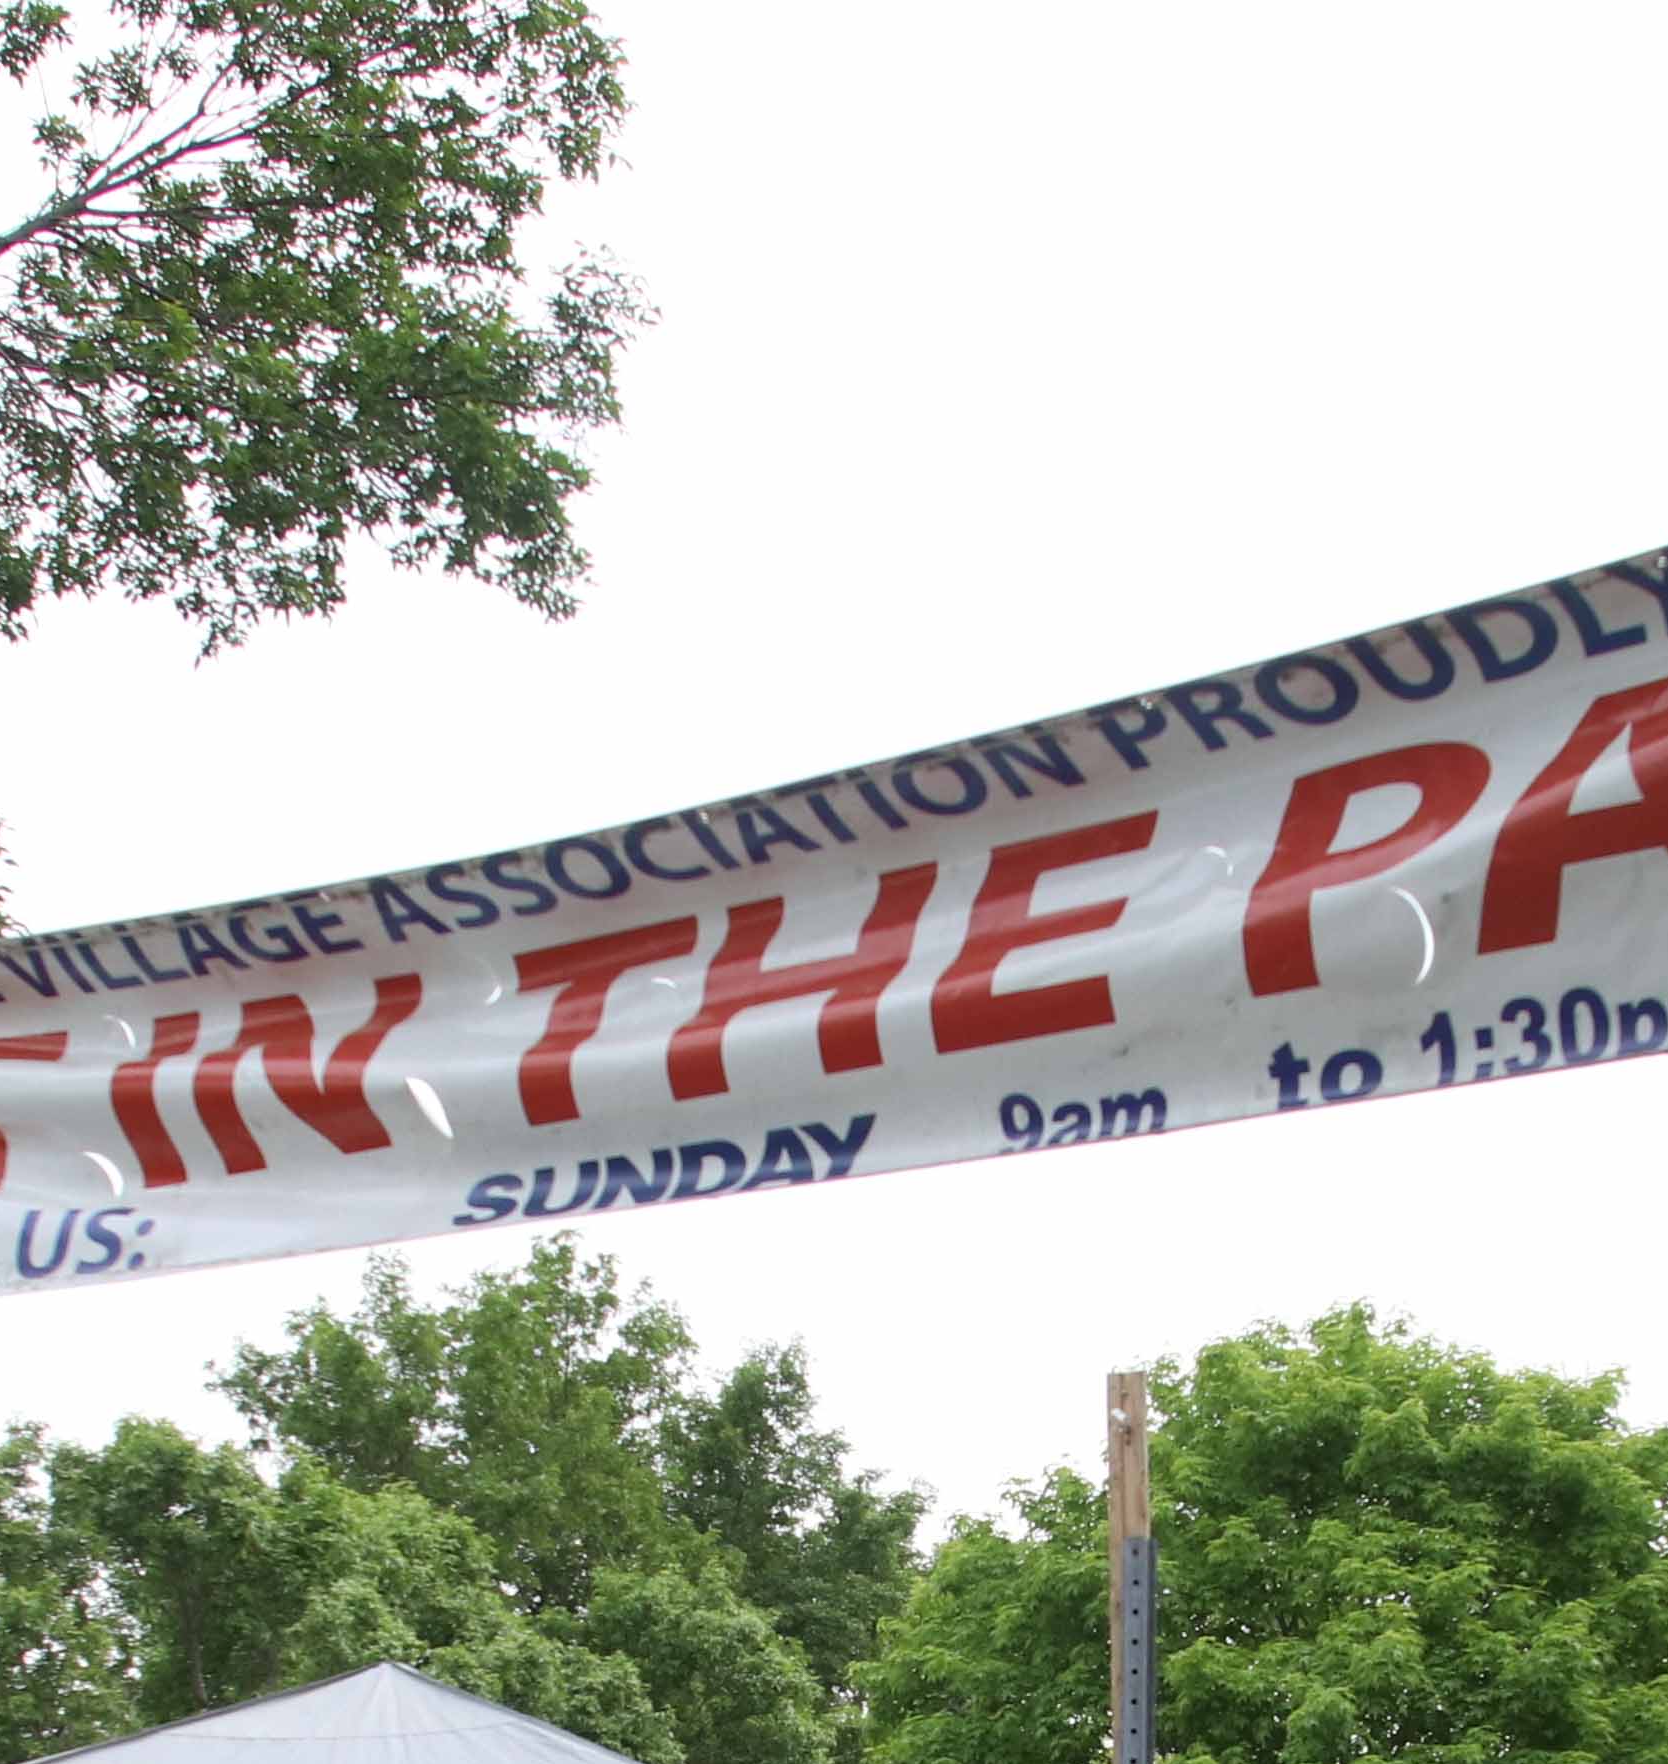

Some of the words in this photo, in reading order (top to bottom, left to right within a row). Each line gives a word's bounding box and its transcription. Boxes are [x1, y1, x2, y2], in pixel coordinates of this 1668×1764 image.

[369, 722, 1088, 944] ASSOCIATION
[110, 972, 423, 1189] IN
[513, 810, 1159, 1127] THE
[16, 1208, 155, 1279] US:
[453, 1113, 876, 1227] SUNDAY
[1000, 1086, 1168, 1154] 9am
[1267, 1042, 1383, 1111] to
